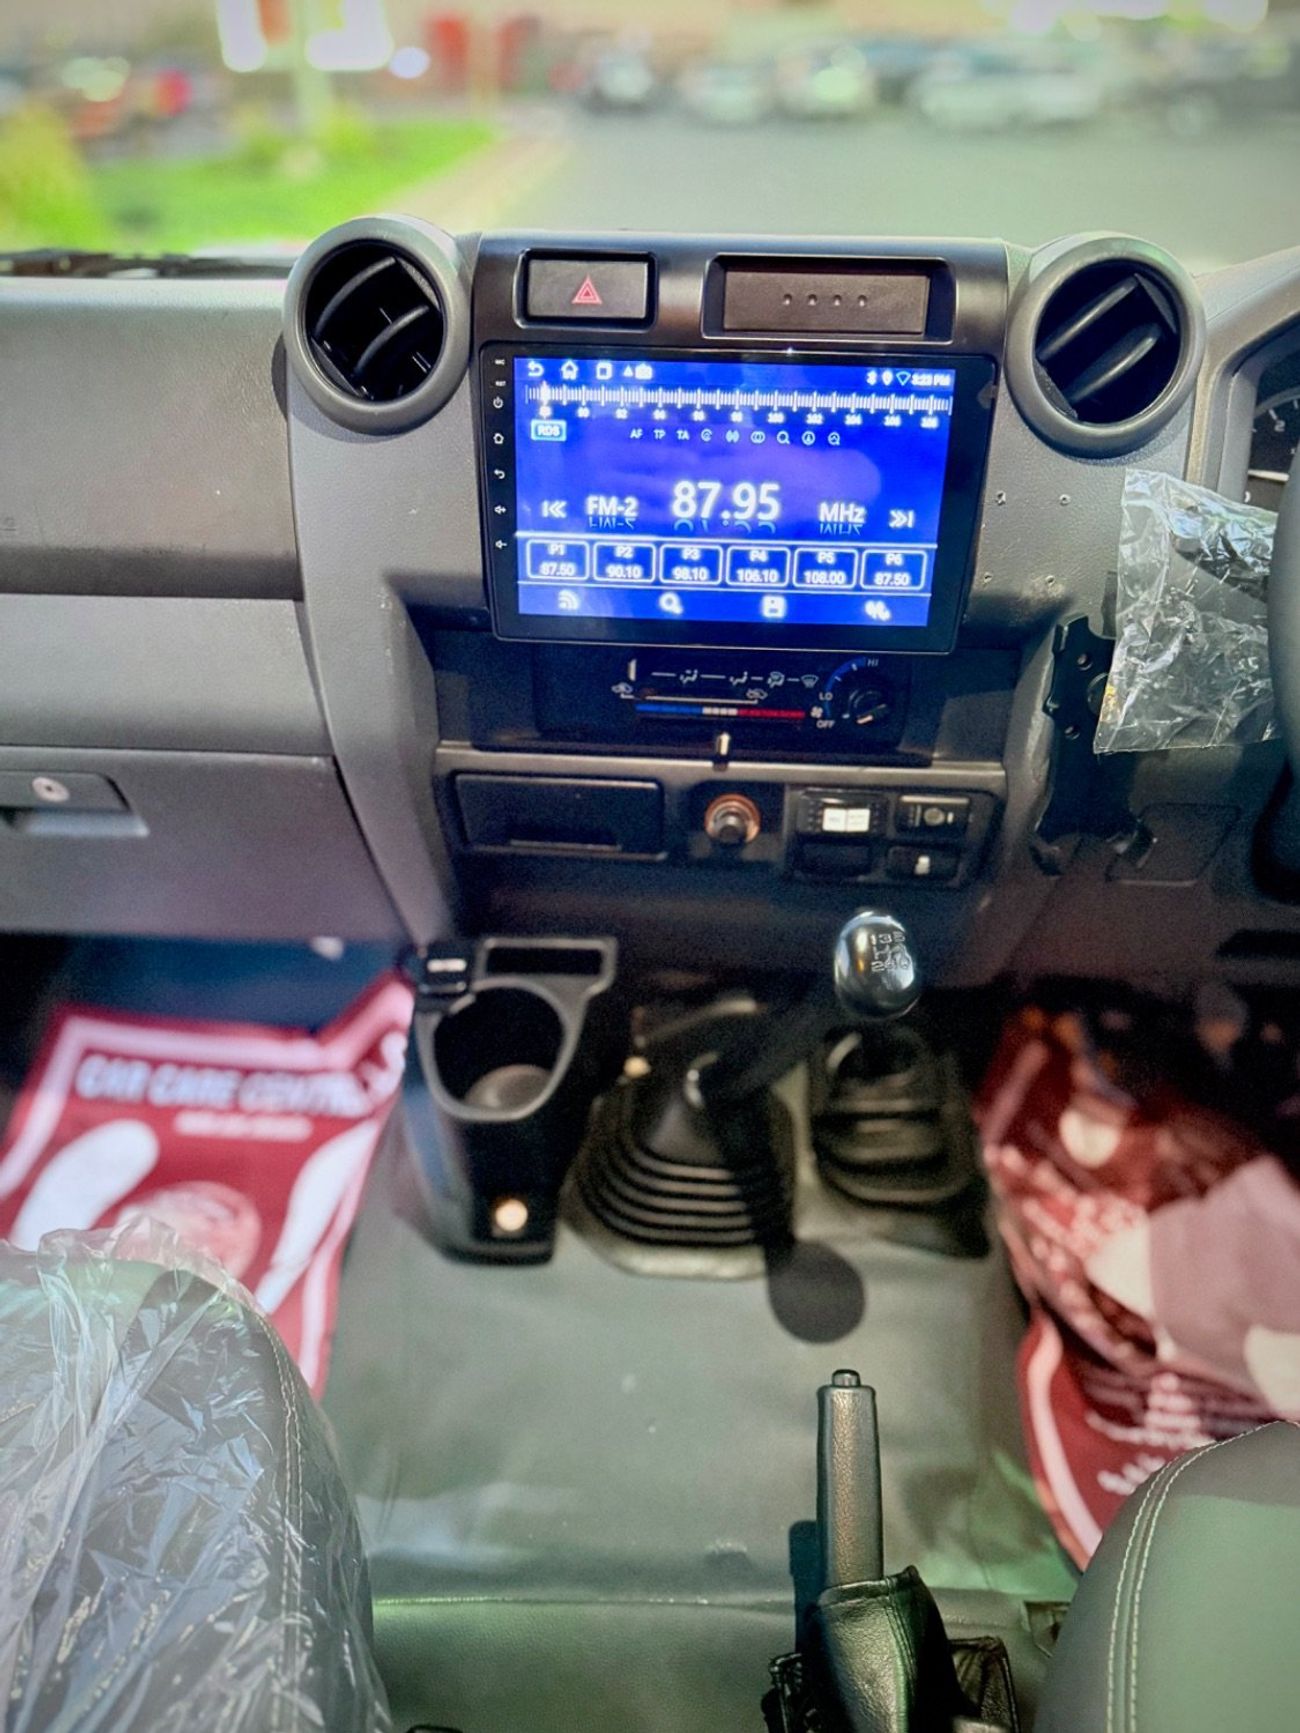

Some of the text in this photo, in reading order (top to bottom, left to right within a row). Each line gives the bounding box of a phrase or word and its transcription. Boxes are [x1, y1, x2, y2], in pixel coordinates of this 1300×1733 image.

[537, 424, 561, 437] RDS
[630, 429, 643, 439] AF
[654, 430, 666, 440] TP
[677, 430, 690, 441] TA
[586, 480, 867, 524] FM-2 87.95 MHz
[549, 543, 566, 556] P1
[614, 545, 634, 558] P2
[681, 547, 700, 560] P3
[749, 549, 769, 562] P4
[816, 551, 835, 564] P5
[885, 552, 903, 566] P6
[539, 562, 577, 577] 87.50
[874, 572, 911, 586] 87.50
[867, 658, 879, 667] HI
[819, 692, 833, 701] LO
[816, 719, 835, 729] OFF
[76, 1054, 149, 1101] CAR
[149, 1063, 241, 1109] CARE
